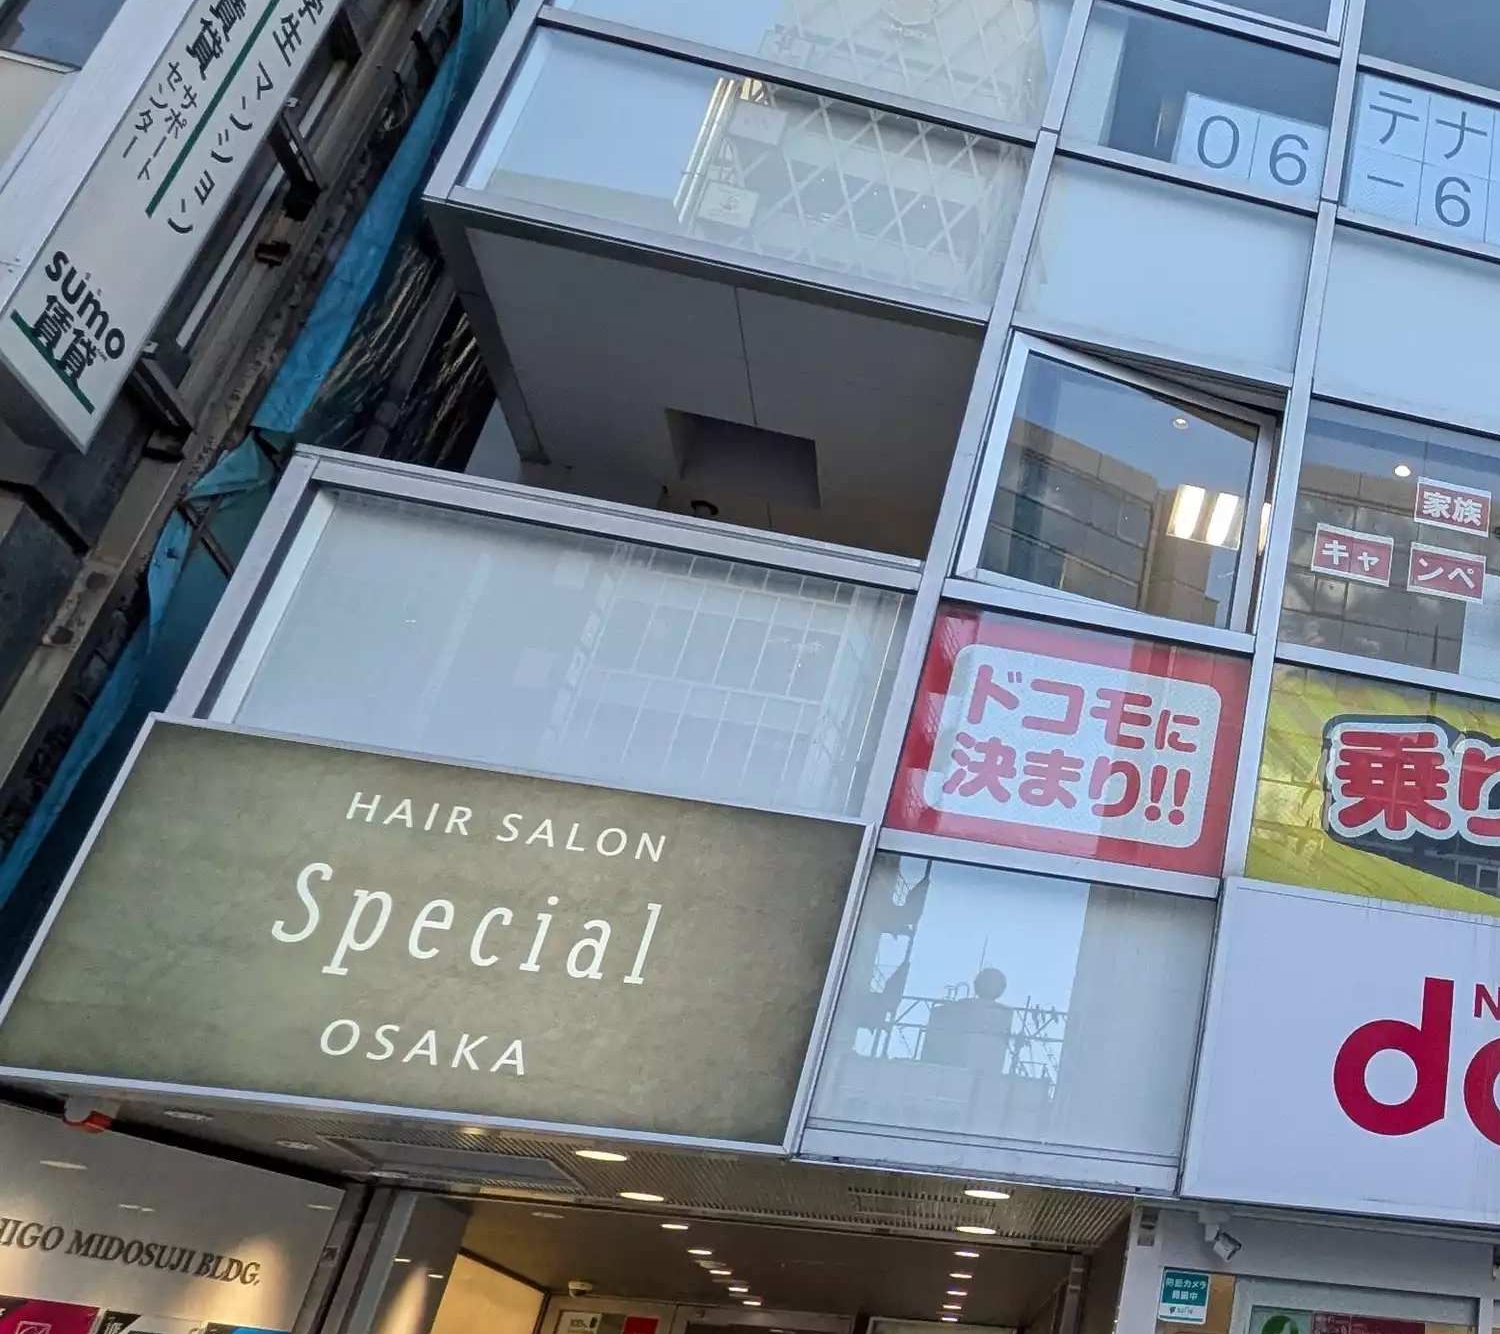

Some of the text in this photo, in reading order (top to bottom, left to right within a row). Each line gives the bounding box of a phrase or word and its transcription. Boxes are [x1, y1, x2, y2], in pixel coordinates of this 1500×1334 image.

[122, 61, 183, 158] センター
[137, 84, 199, 181] サポート
[1197, 113, 1311, 188] 06
[31, 295, 98, 388] 賃貸
[965, 663, 1202, 754] ドコモに
[942, 731, 1192, 827] 決まり!!
[346, 791, 667, 863] HAIR SALON
[271, 861, 664, 985] Special
[320, 1018, 528, 1077] OSAKA
[65, 1230, 193, 1276] MIDOSUJI
